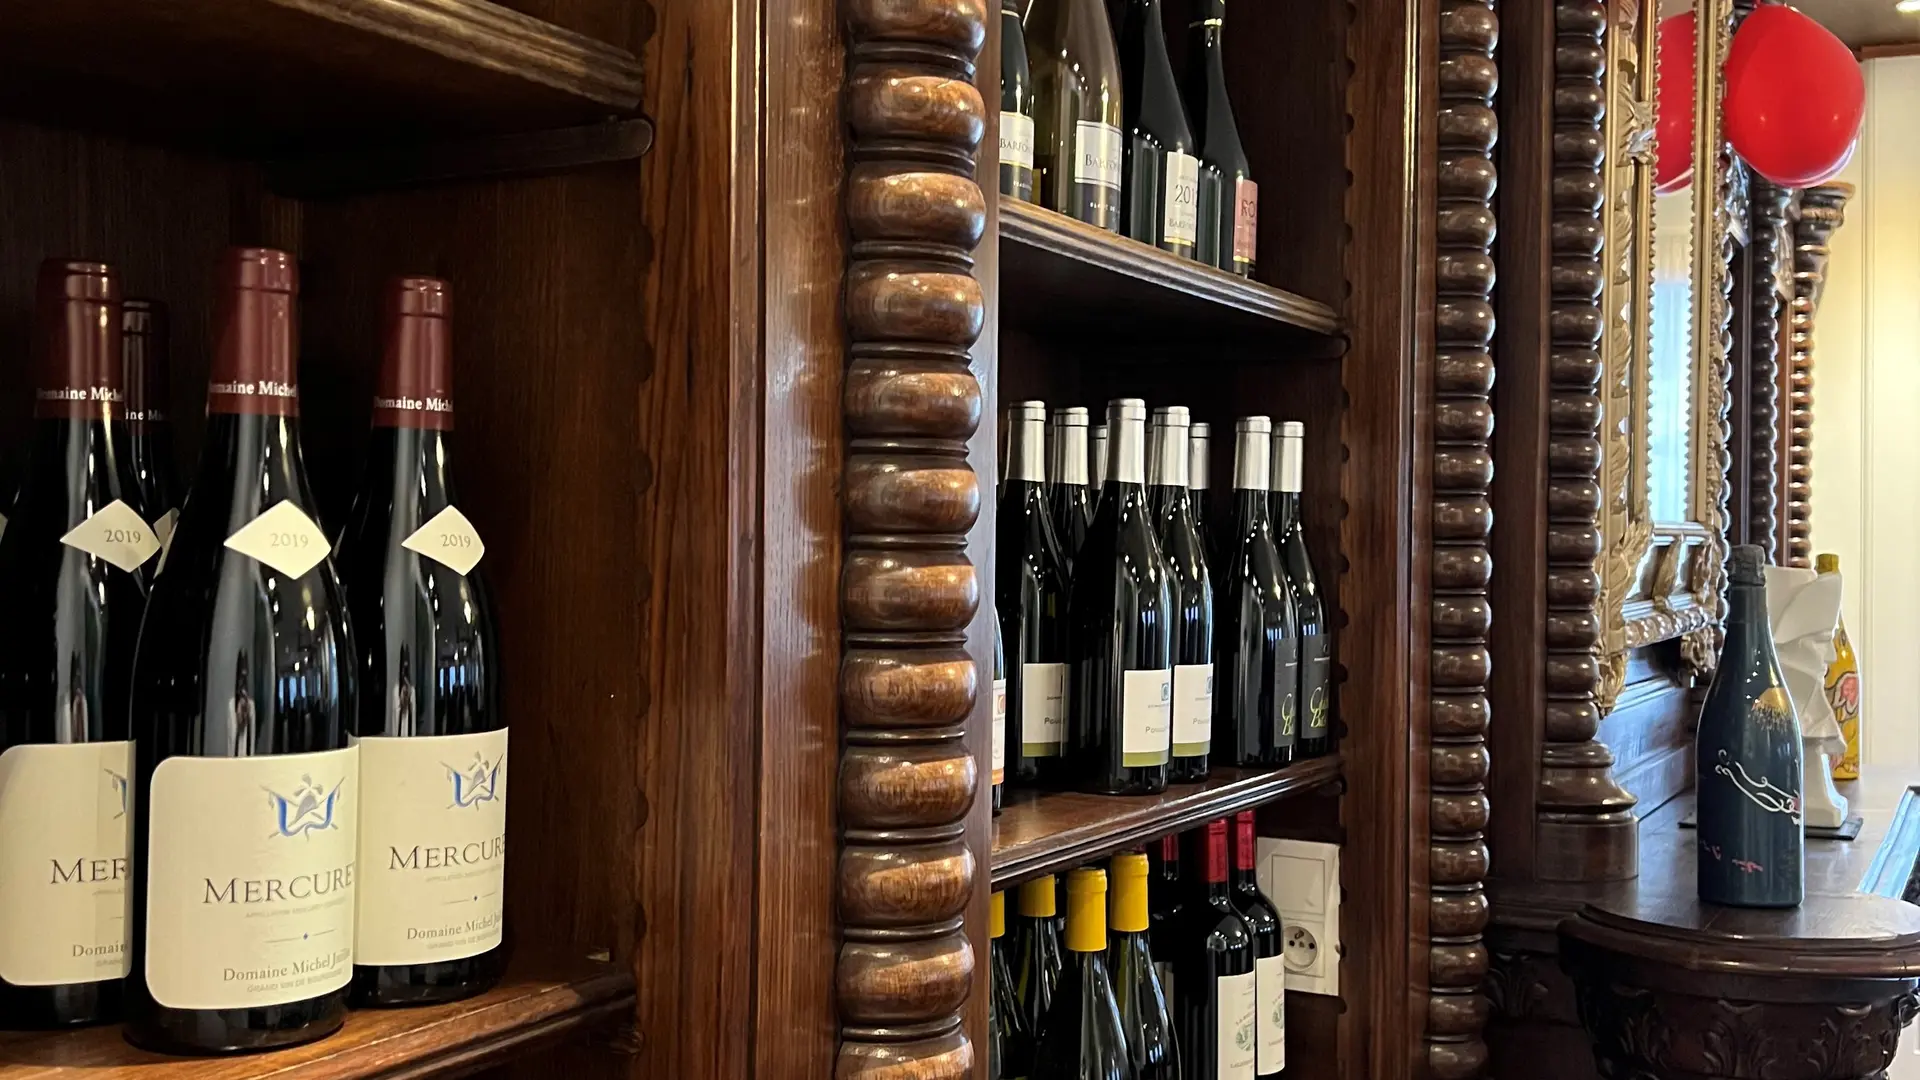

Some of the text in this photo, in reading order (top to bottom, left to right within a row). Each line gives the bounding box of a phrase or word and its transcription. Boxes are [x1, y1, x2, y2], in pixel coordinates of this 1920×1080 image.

[104, 530, 141, 543] 2019
[270, 533, 309, 547] 2019
[441, 534, 471, 547] 2019
[406, 924, 462, 940] Domaine
[223, 966, 288, 981] Domaine
[291, 954, 330, 975] Michel
